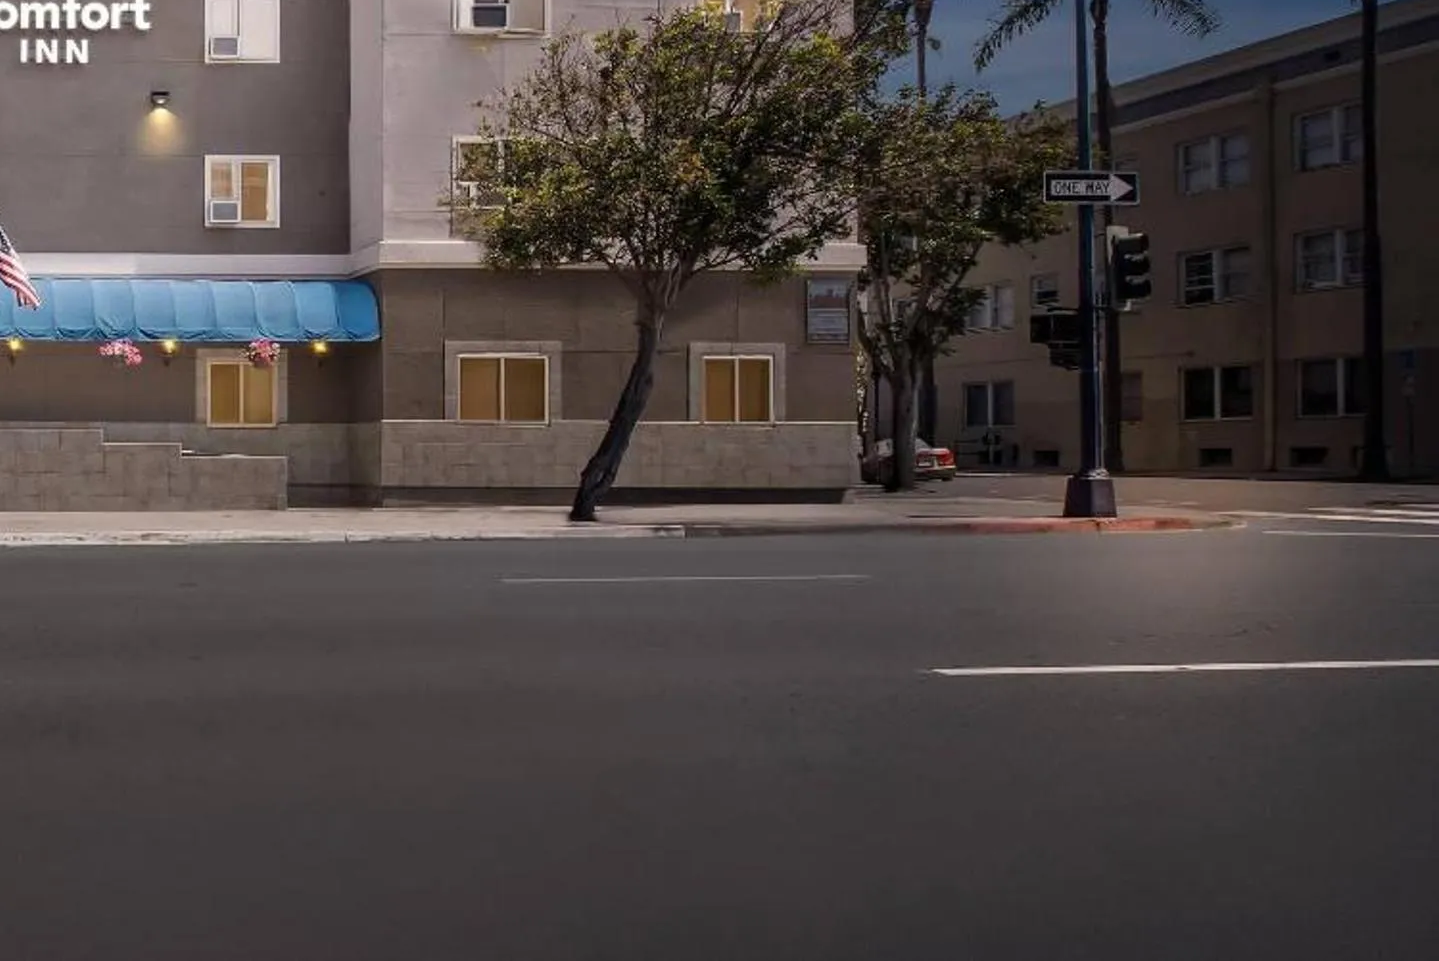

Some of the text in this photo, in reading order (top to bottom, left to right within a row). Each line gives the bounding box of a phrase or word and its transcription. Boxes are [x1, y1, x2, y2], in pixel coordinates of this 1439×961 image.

[20, 38, 90, 64] INN
[1054, 181, 1110, 194] ONE WAY
